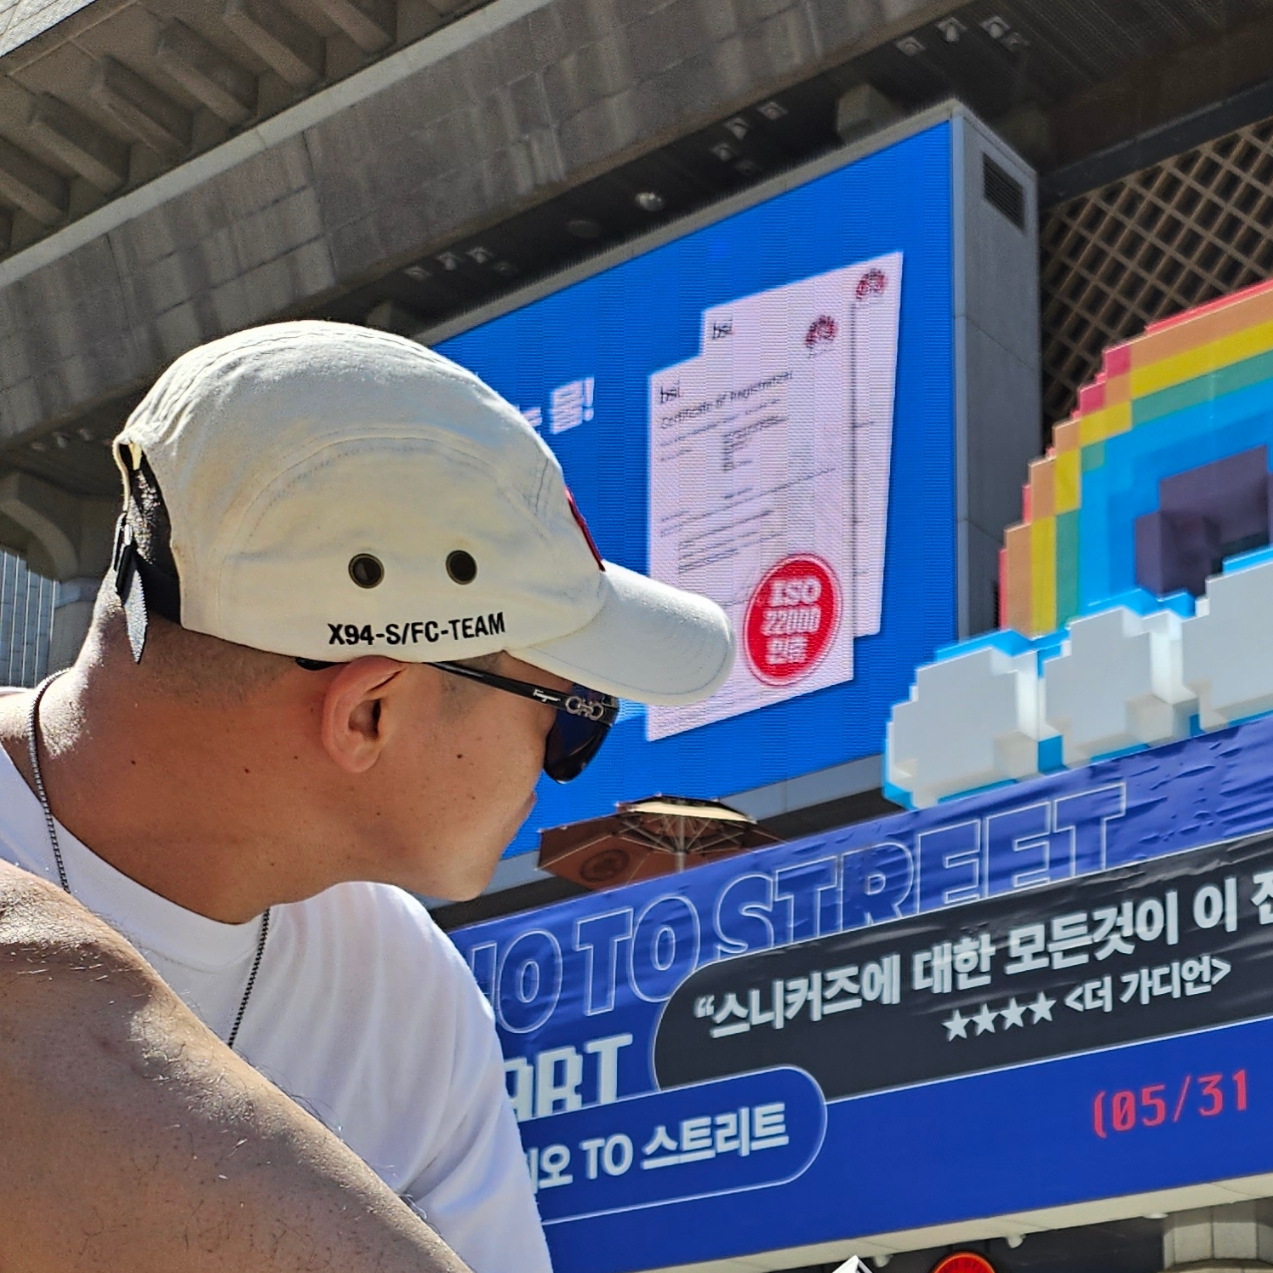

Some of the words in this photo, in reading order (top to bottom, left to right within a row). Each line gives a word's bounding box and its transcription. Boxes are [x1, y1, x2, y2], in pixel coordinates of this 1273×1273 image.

[768, 576, 822, 606] ISO
[327, 612, 506, 646] X94-S/FC-TEAM
[575, 895, 700, 1017] TO
[712, 781, 1127, 960] STREET
[912, 932, 997, 996] 대한
[1003, 889, 1178, 977] 모든것이
[1193, 876, 1238, 933] 이
[1119, 954, 1231, 1005] 가디언>
[1093, 1068, 1248, 1138] (05/31
[579, 1132, 634, 1180] TO
[640, 1101, 790, 1170] 스트리트
